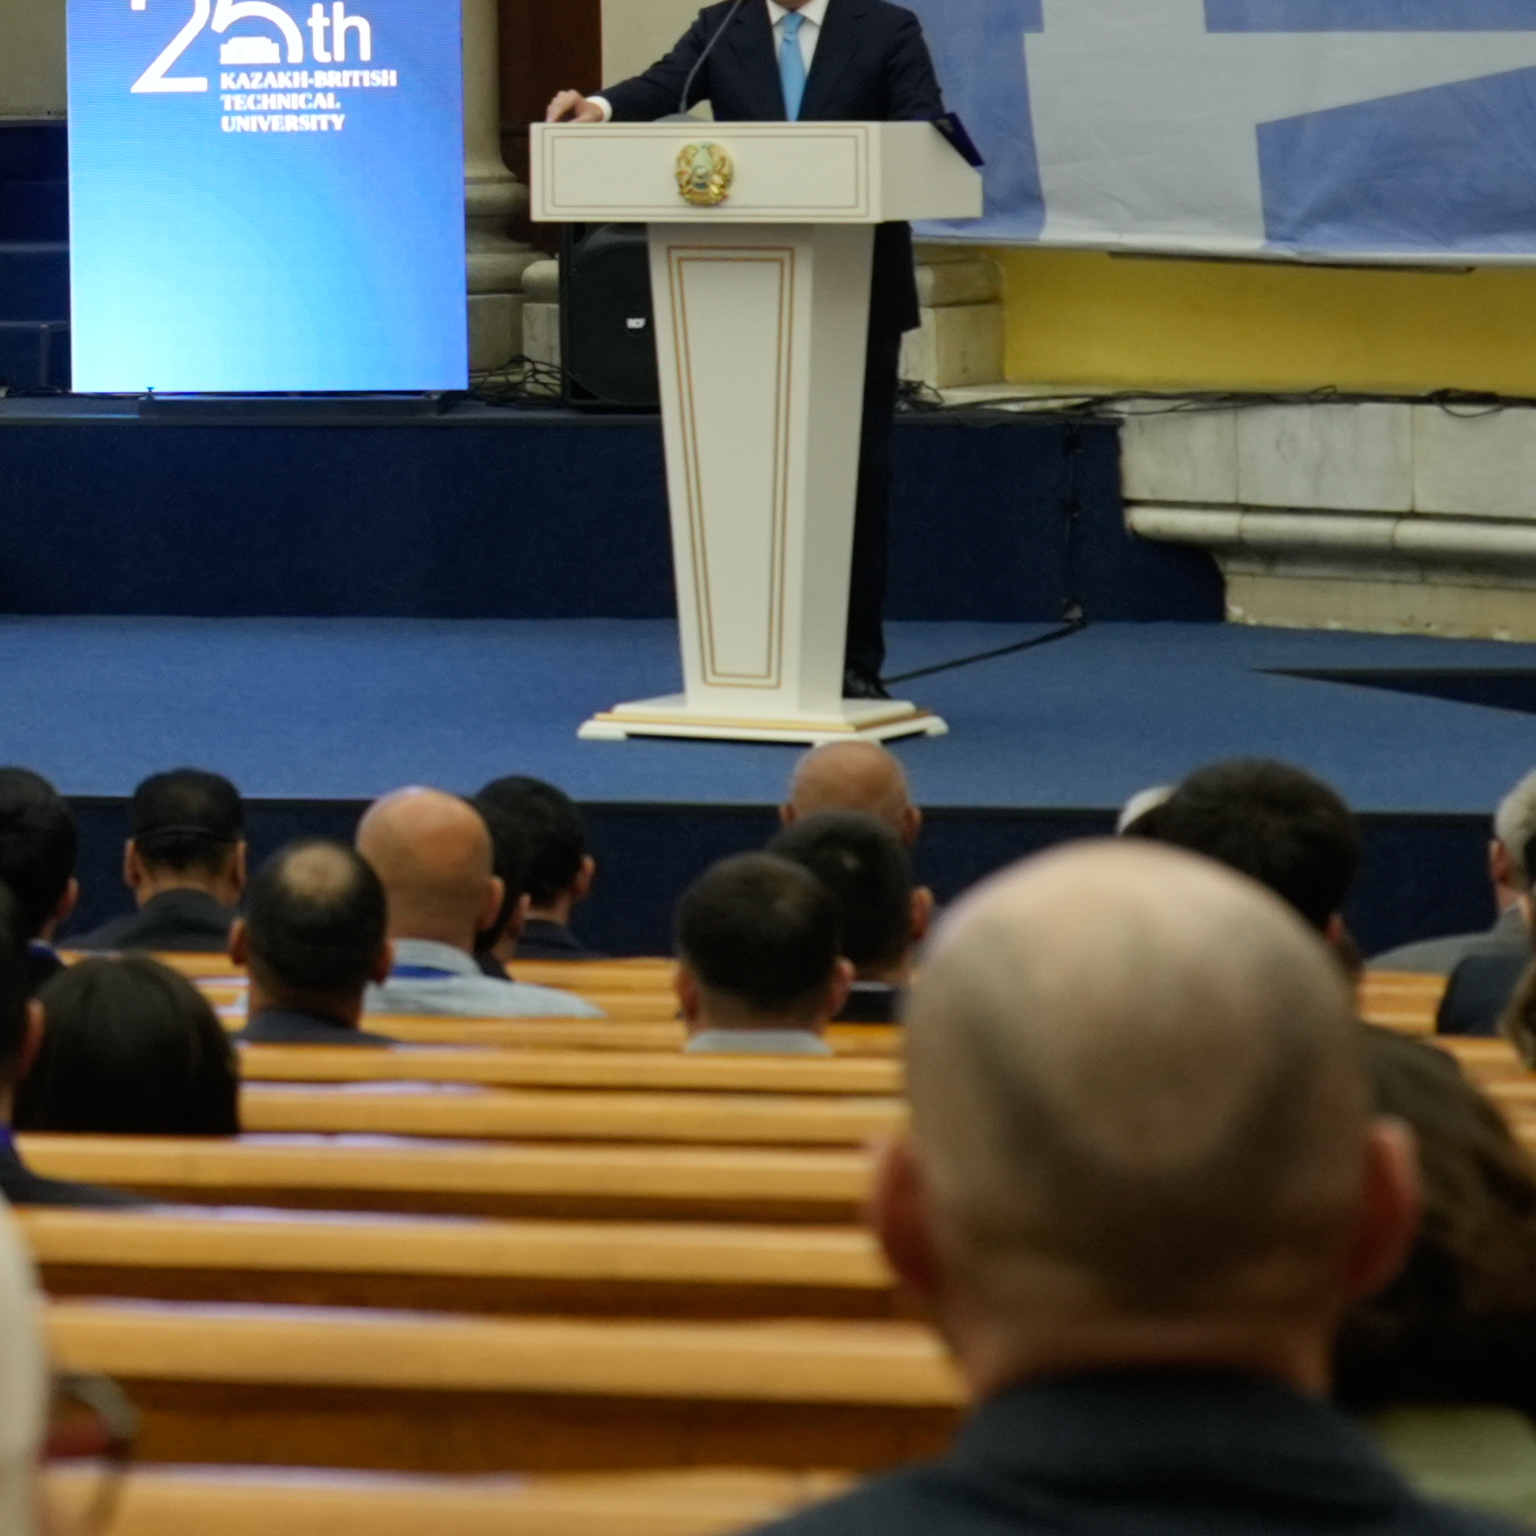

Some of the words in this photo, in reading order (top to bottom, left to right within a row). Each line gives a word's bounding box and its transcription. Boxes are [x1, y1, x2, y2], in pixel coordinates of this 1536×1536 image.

[220, 70, 396, 89] KAZAKH-BRITISH
[221, 93, 340, 110] TECHNICAL
[221, 114, 344, 132] UNIVERSITY
